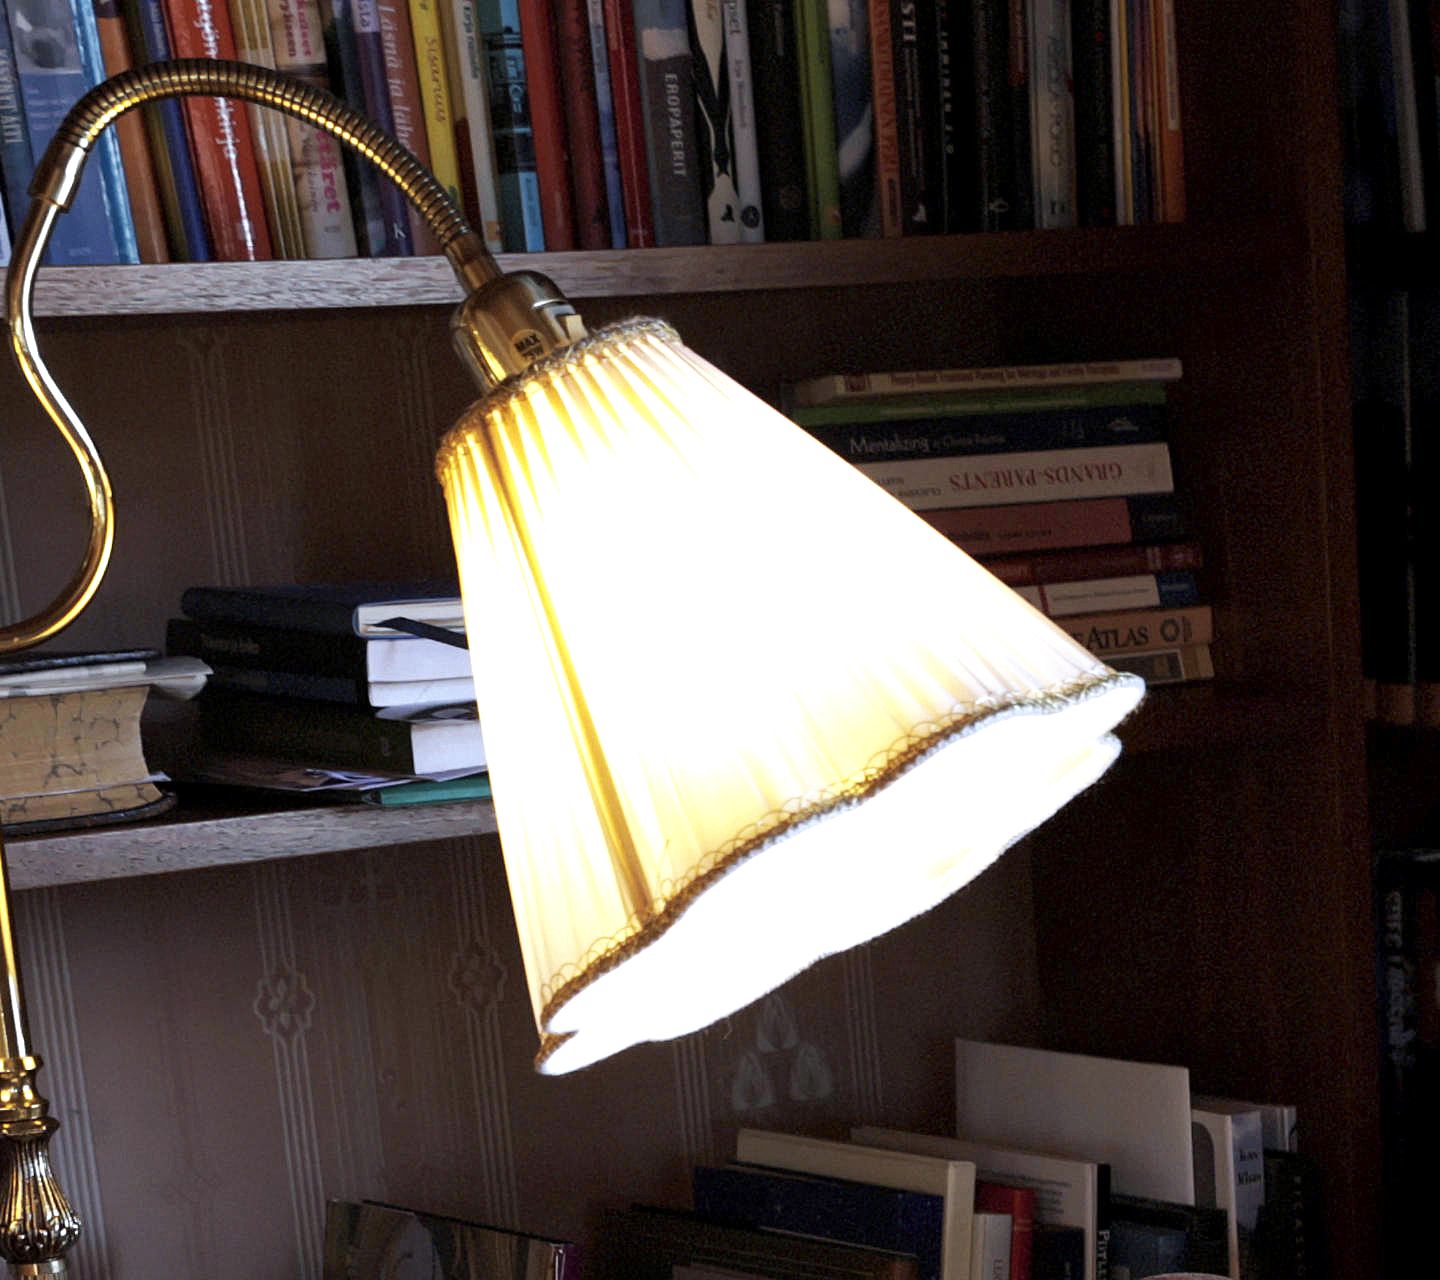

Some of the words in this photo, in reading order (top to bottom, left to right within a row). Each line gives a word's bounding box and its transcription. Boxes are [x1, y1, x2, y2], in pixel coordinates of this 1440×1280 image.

[663, 72, 689, 177] EROPAPERIT
[849, 432, 931, 456] Mentalizing
[949, 461, 1125, 492] GRANDS-PARENTS
[1086, 626, 1150, 652] ATLAS
